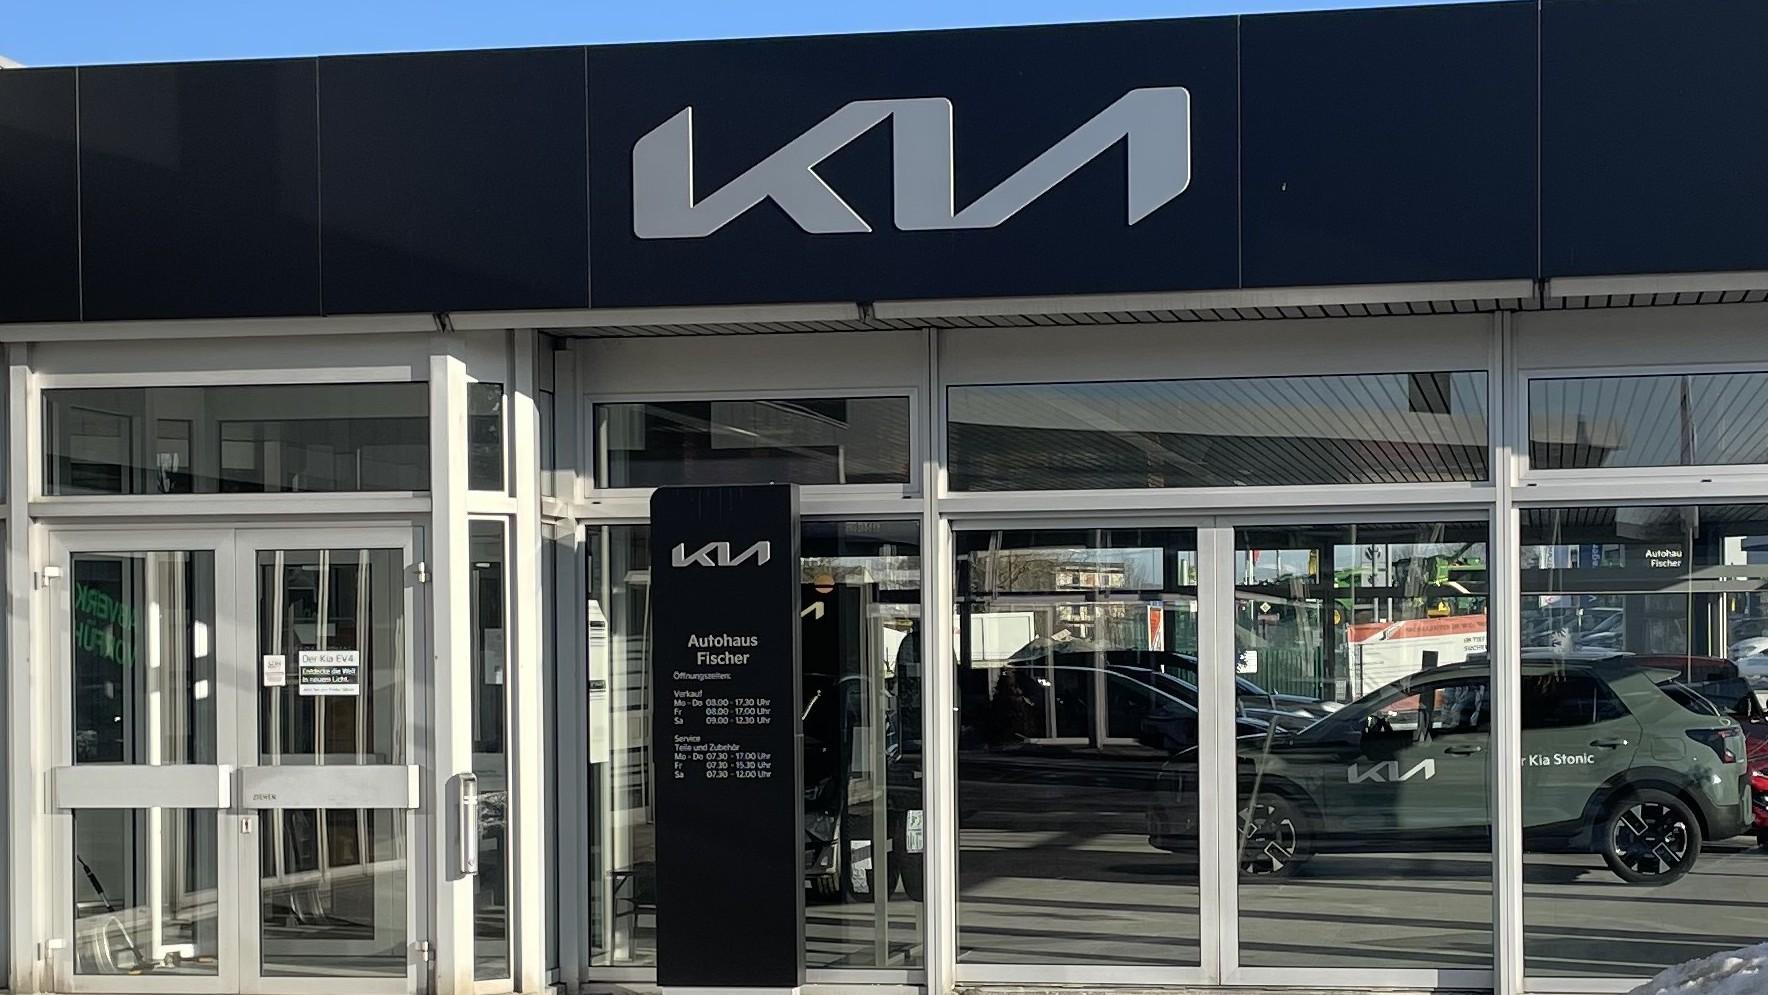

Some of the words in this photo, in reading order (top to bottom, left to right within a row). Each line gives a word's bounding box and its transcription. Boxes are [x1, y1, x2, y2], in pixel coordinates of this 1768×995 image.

[632, 86, 1191, 239] KIA
[671, 540, 771, 568] KIA
[1651, 559, 1681, 568] Fischer
[687, 633, 758, 648] Autohaus
[302, 654, 317, 663] Der
[319, 654, 333, 663] Kia
[335, 654, 354, 663] EV4
[696, 651, 750, 665] Fischer
[673, 671, 732, 682] Öffnungszeiten:
[673, 690, 703, 698] Verkauf
[673, 699, 686, 707] Mo
[692, 699, 703, 707] Do
[735, 699, 755, 707] 17.30
[756, 699, 771, 707] Uhr
[673, 708, 683, 716] Fr
[735, 708, 756, 716] 17.00
[756, 708, 771, 716] Uhr
[673, 717, 684, 725] Sa
[756, 717, 771, 725] Uhr
[674, 734, 701, 743] Service
[674, 743, 692, 751] Teile
[693, 743, 708, 751] und
[709, 743, 740, 751] Zubehör
[674, 752, 687, 760] Mo
[692, 752, 704, 760] Do
[757, 752, 771, 760] Uhr
[1528, 754, 1550, 766] Kia
[1553, 753, 1595, 765] Stonic
[674, 761, 683, 769] Fr
[757, 761, 772, 769] Uhr
[674, 770, 684, 778] Sa
[757, 770, 772, 778] Uhr
[1347, 758, 1436, 784] KIA
